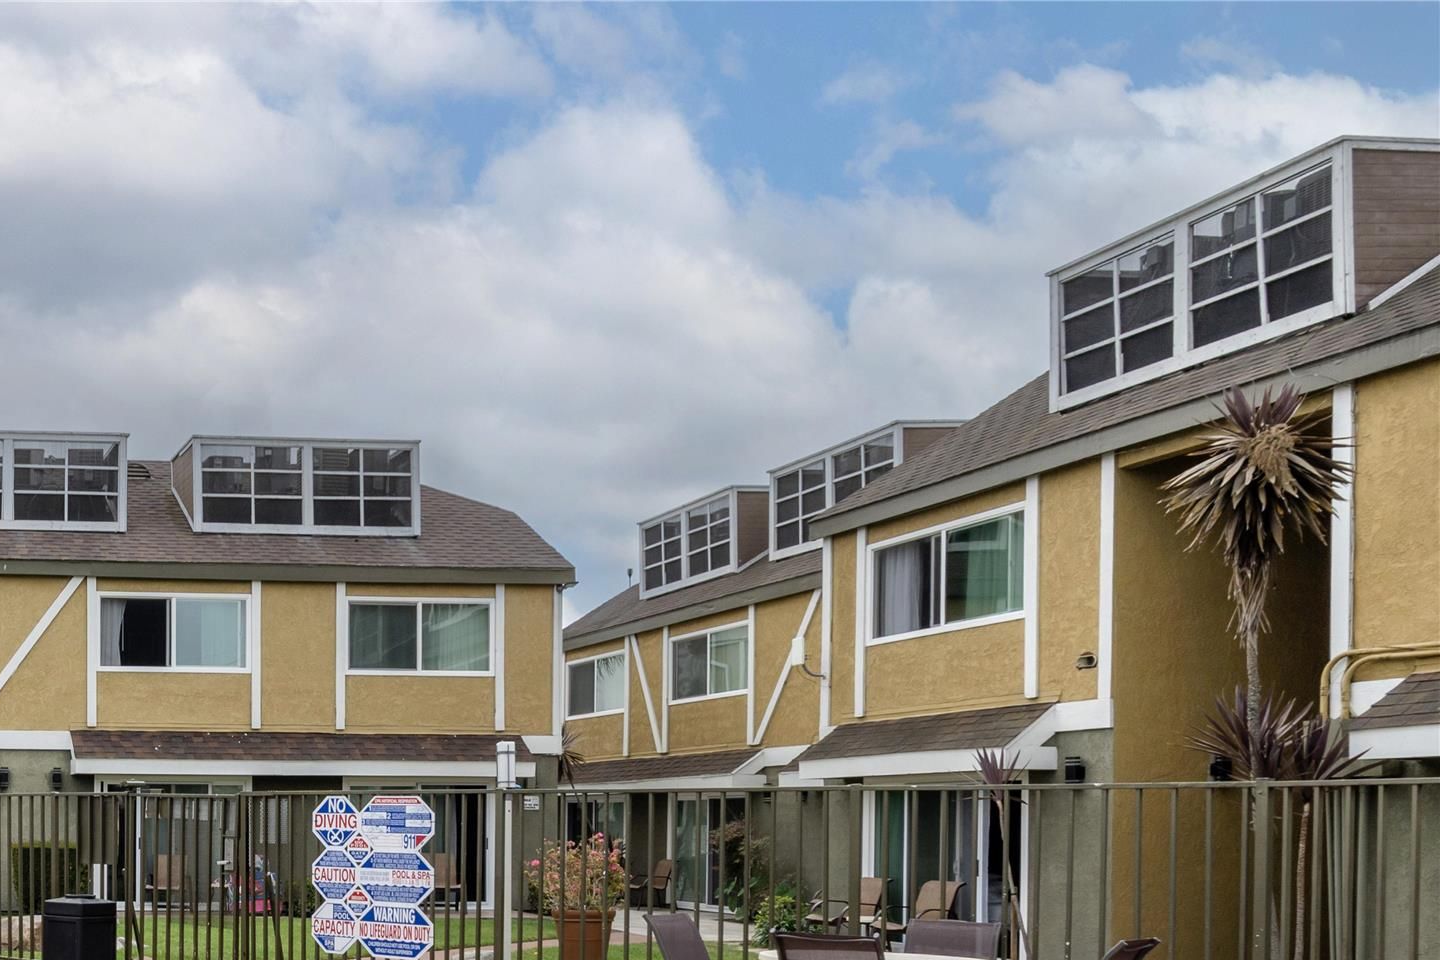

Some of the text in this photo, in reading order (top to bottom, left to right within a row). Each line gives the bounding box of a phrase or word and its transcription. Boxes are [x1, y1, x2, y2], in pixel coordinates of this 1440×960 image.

[328, 800, 346, 813] NO
[315, 814, 357, 829] DIVING
[404, 834, 416, 849] 911
[314, 867, 356, 882] CAUTION
[392, 870, 410, 878] POOL
[417, 871, 430, 879] SPA
[373, 907, 416, 923] WARNING
[313, 920, 356, 936] CAPACITY
[360, 925, 431, 941] NO LIFEGUARD ON DUTY
